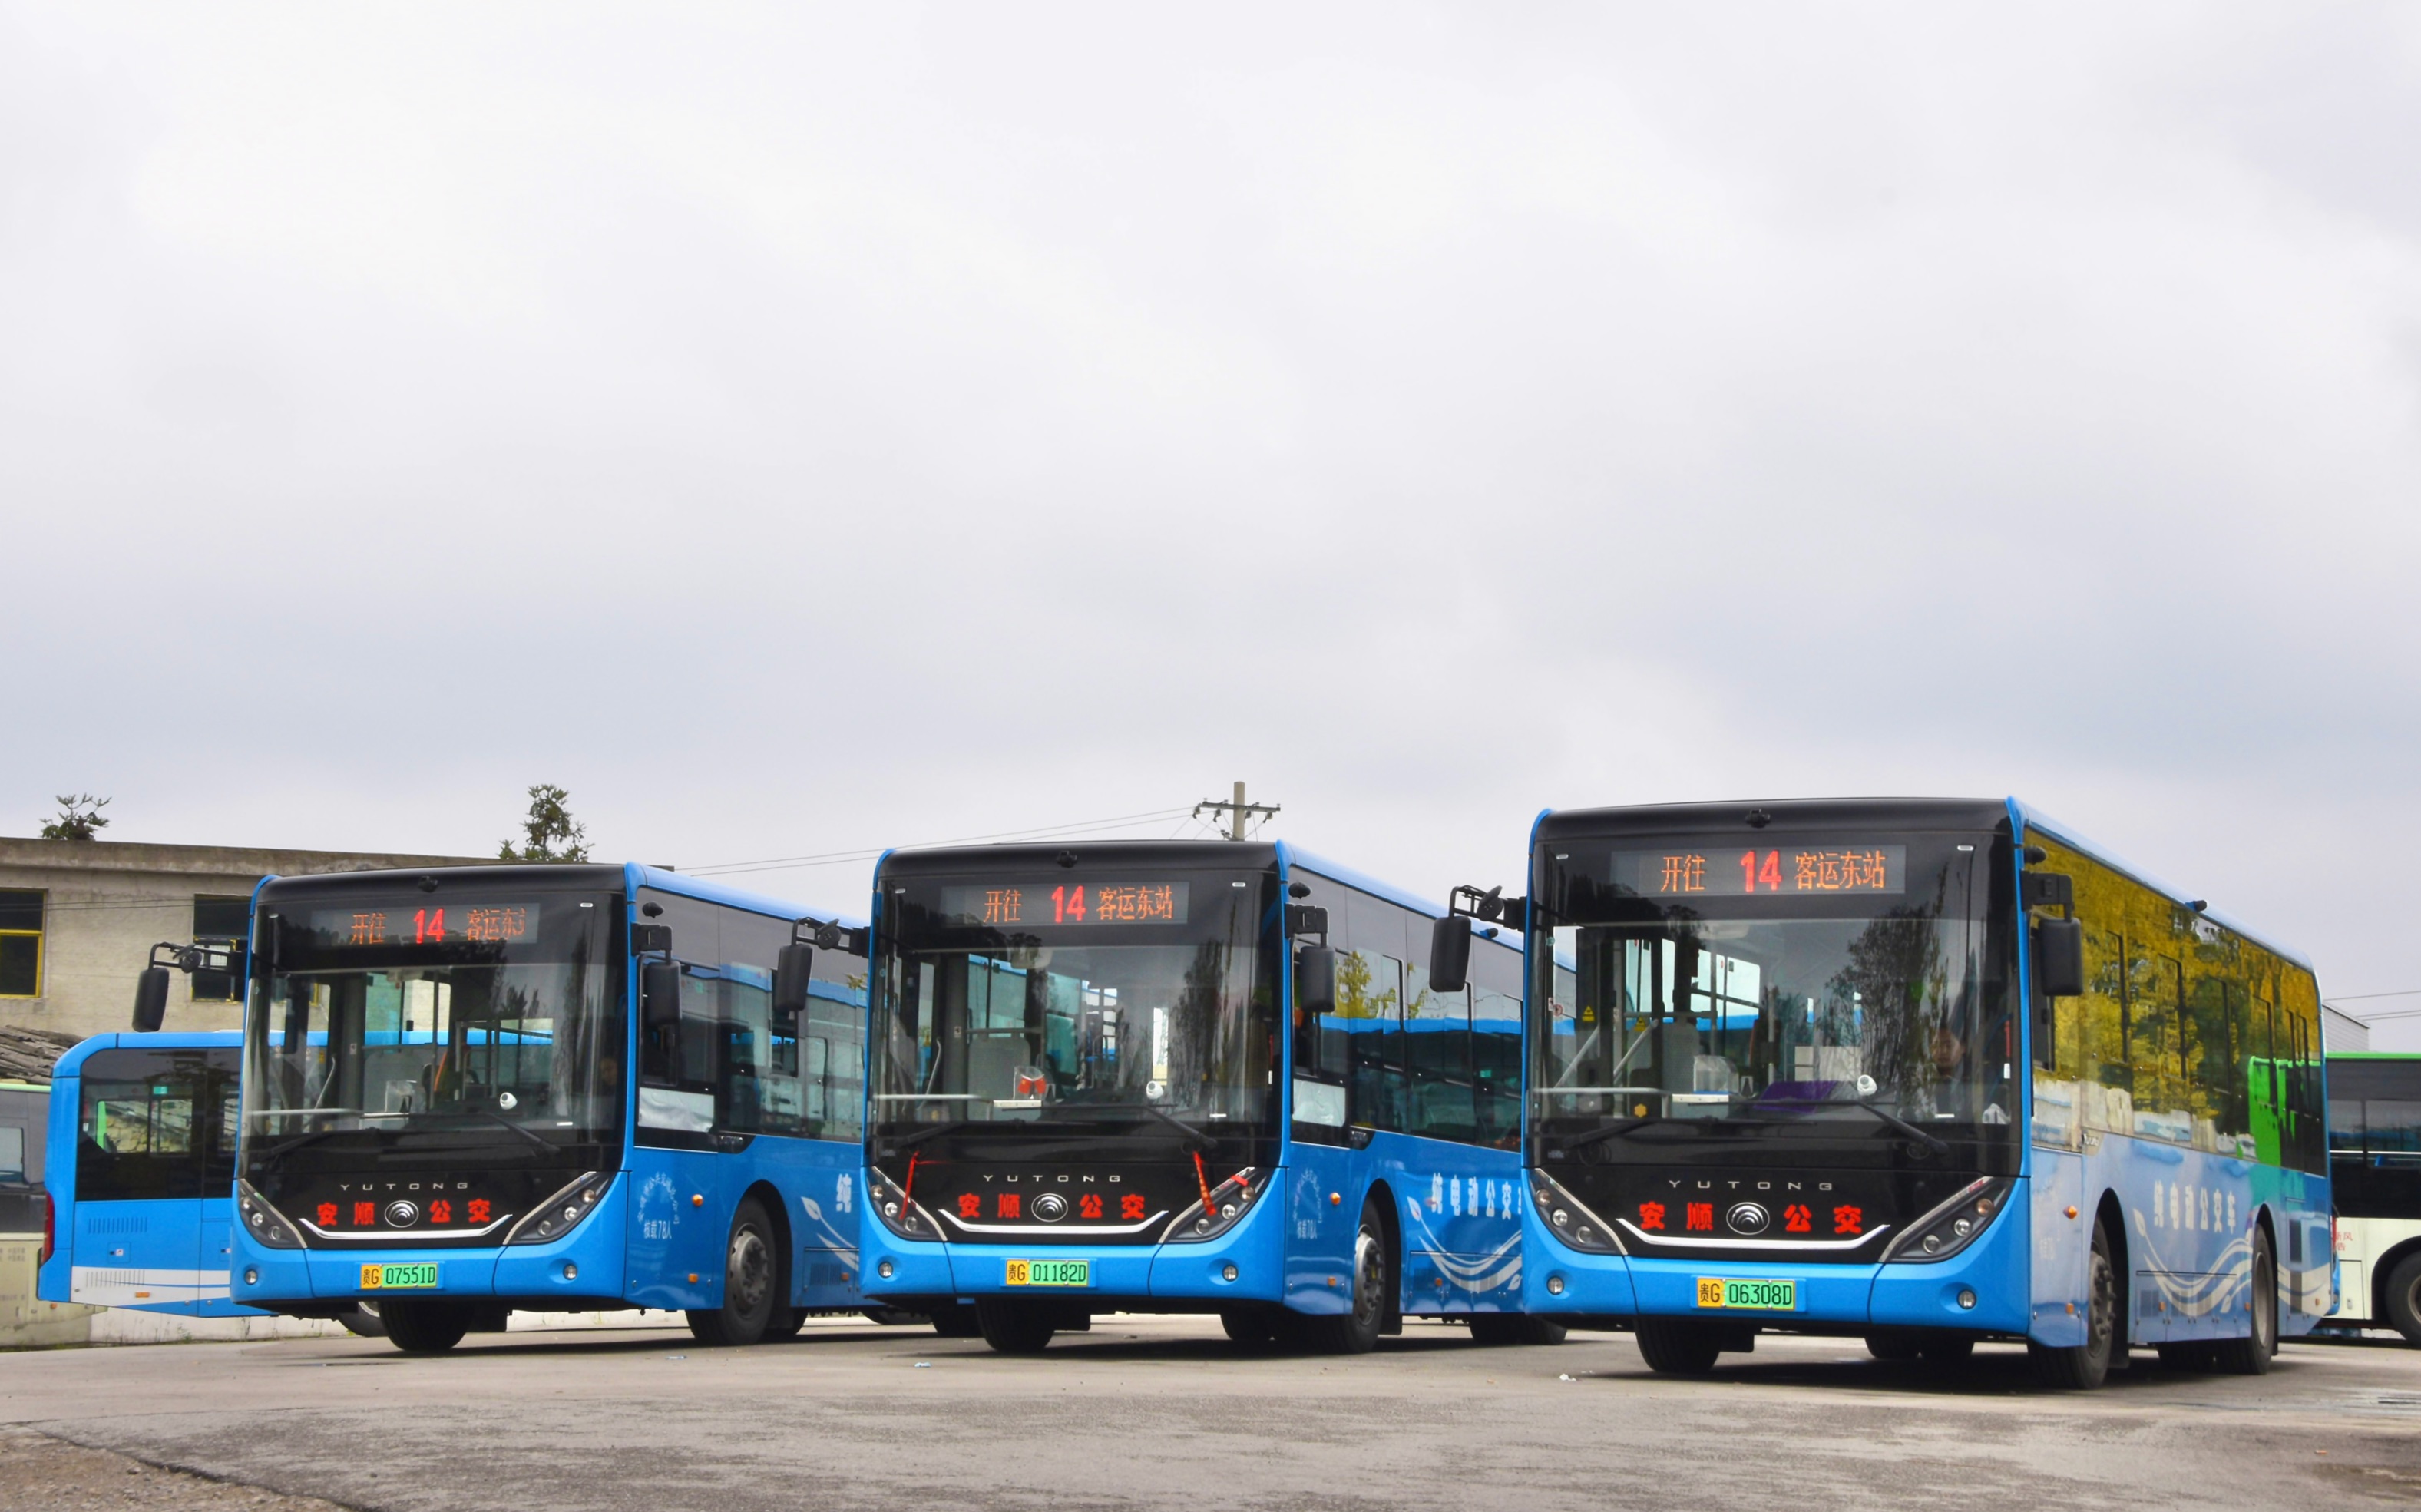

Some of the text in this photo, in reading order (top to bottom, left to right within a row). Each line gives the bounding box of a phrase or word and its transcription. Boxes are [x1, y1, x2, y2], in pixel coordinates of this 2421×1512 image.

[1661, 849, 1886, 892] 开往 14 客运东站
[984, 885, 1173, 923] 开往 14 客运东站
[350, 912, 386, 945] 开往
[413, 908, 445, 944] 14
[340, 1183, 468, 1191] YUTONG
[1669, 1180, 1833, 1190] YUTONG
